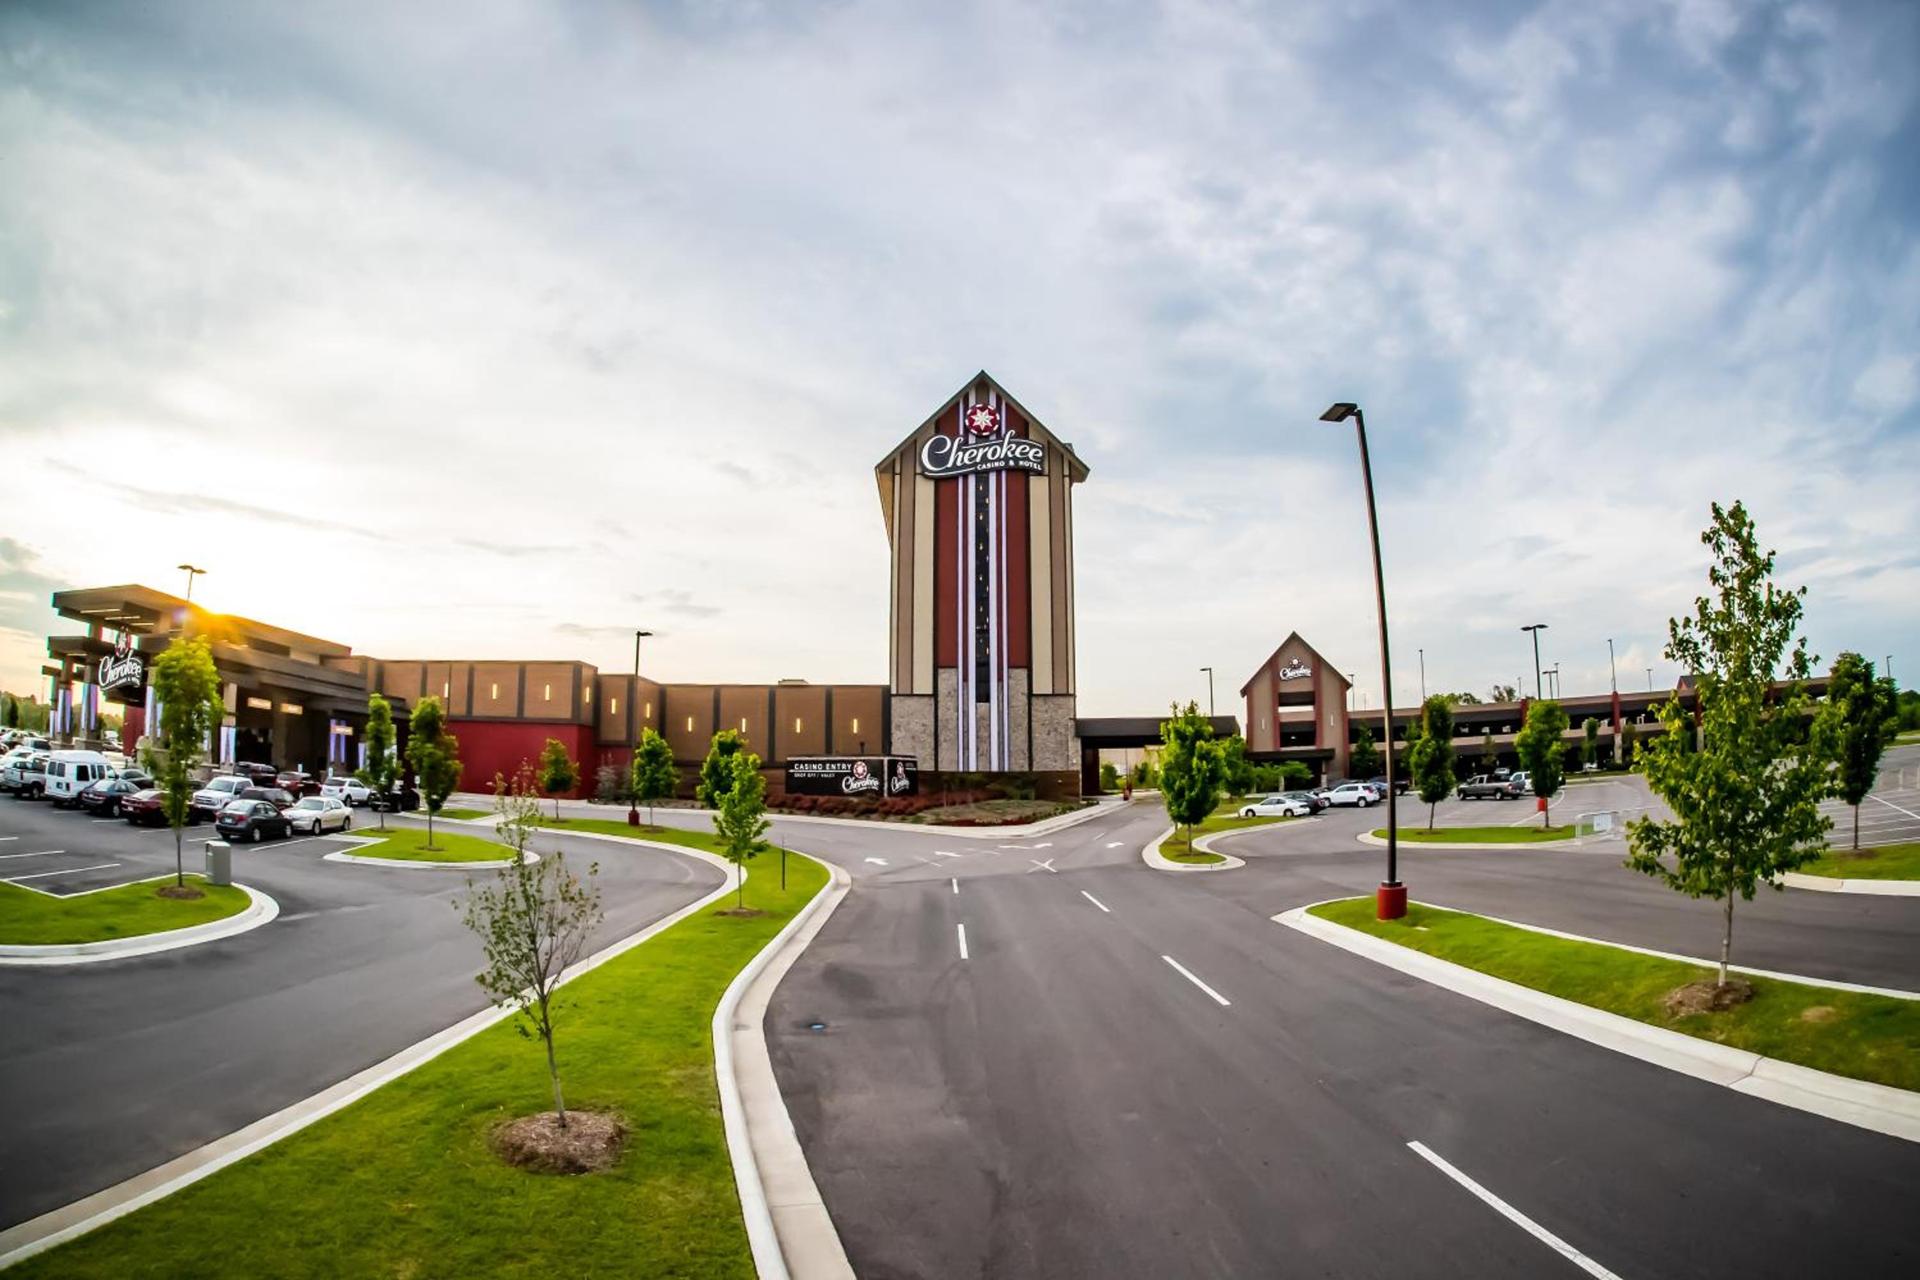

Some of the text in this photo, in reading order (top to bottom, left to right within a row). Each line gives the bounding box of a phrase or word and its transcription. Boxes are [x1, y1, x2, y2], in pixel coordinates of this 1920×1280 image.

[921, 430, 1043, 471] Cherokee
[976, 460, 1005, 471] CASINO
[1019, 460, 1042, 471] HOTEL
[98, 649, 142, 686] Cherokee
